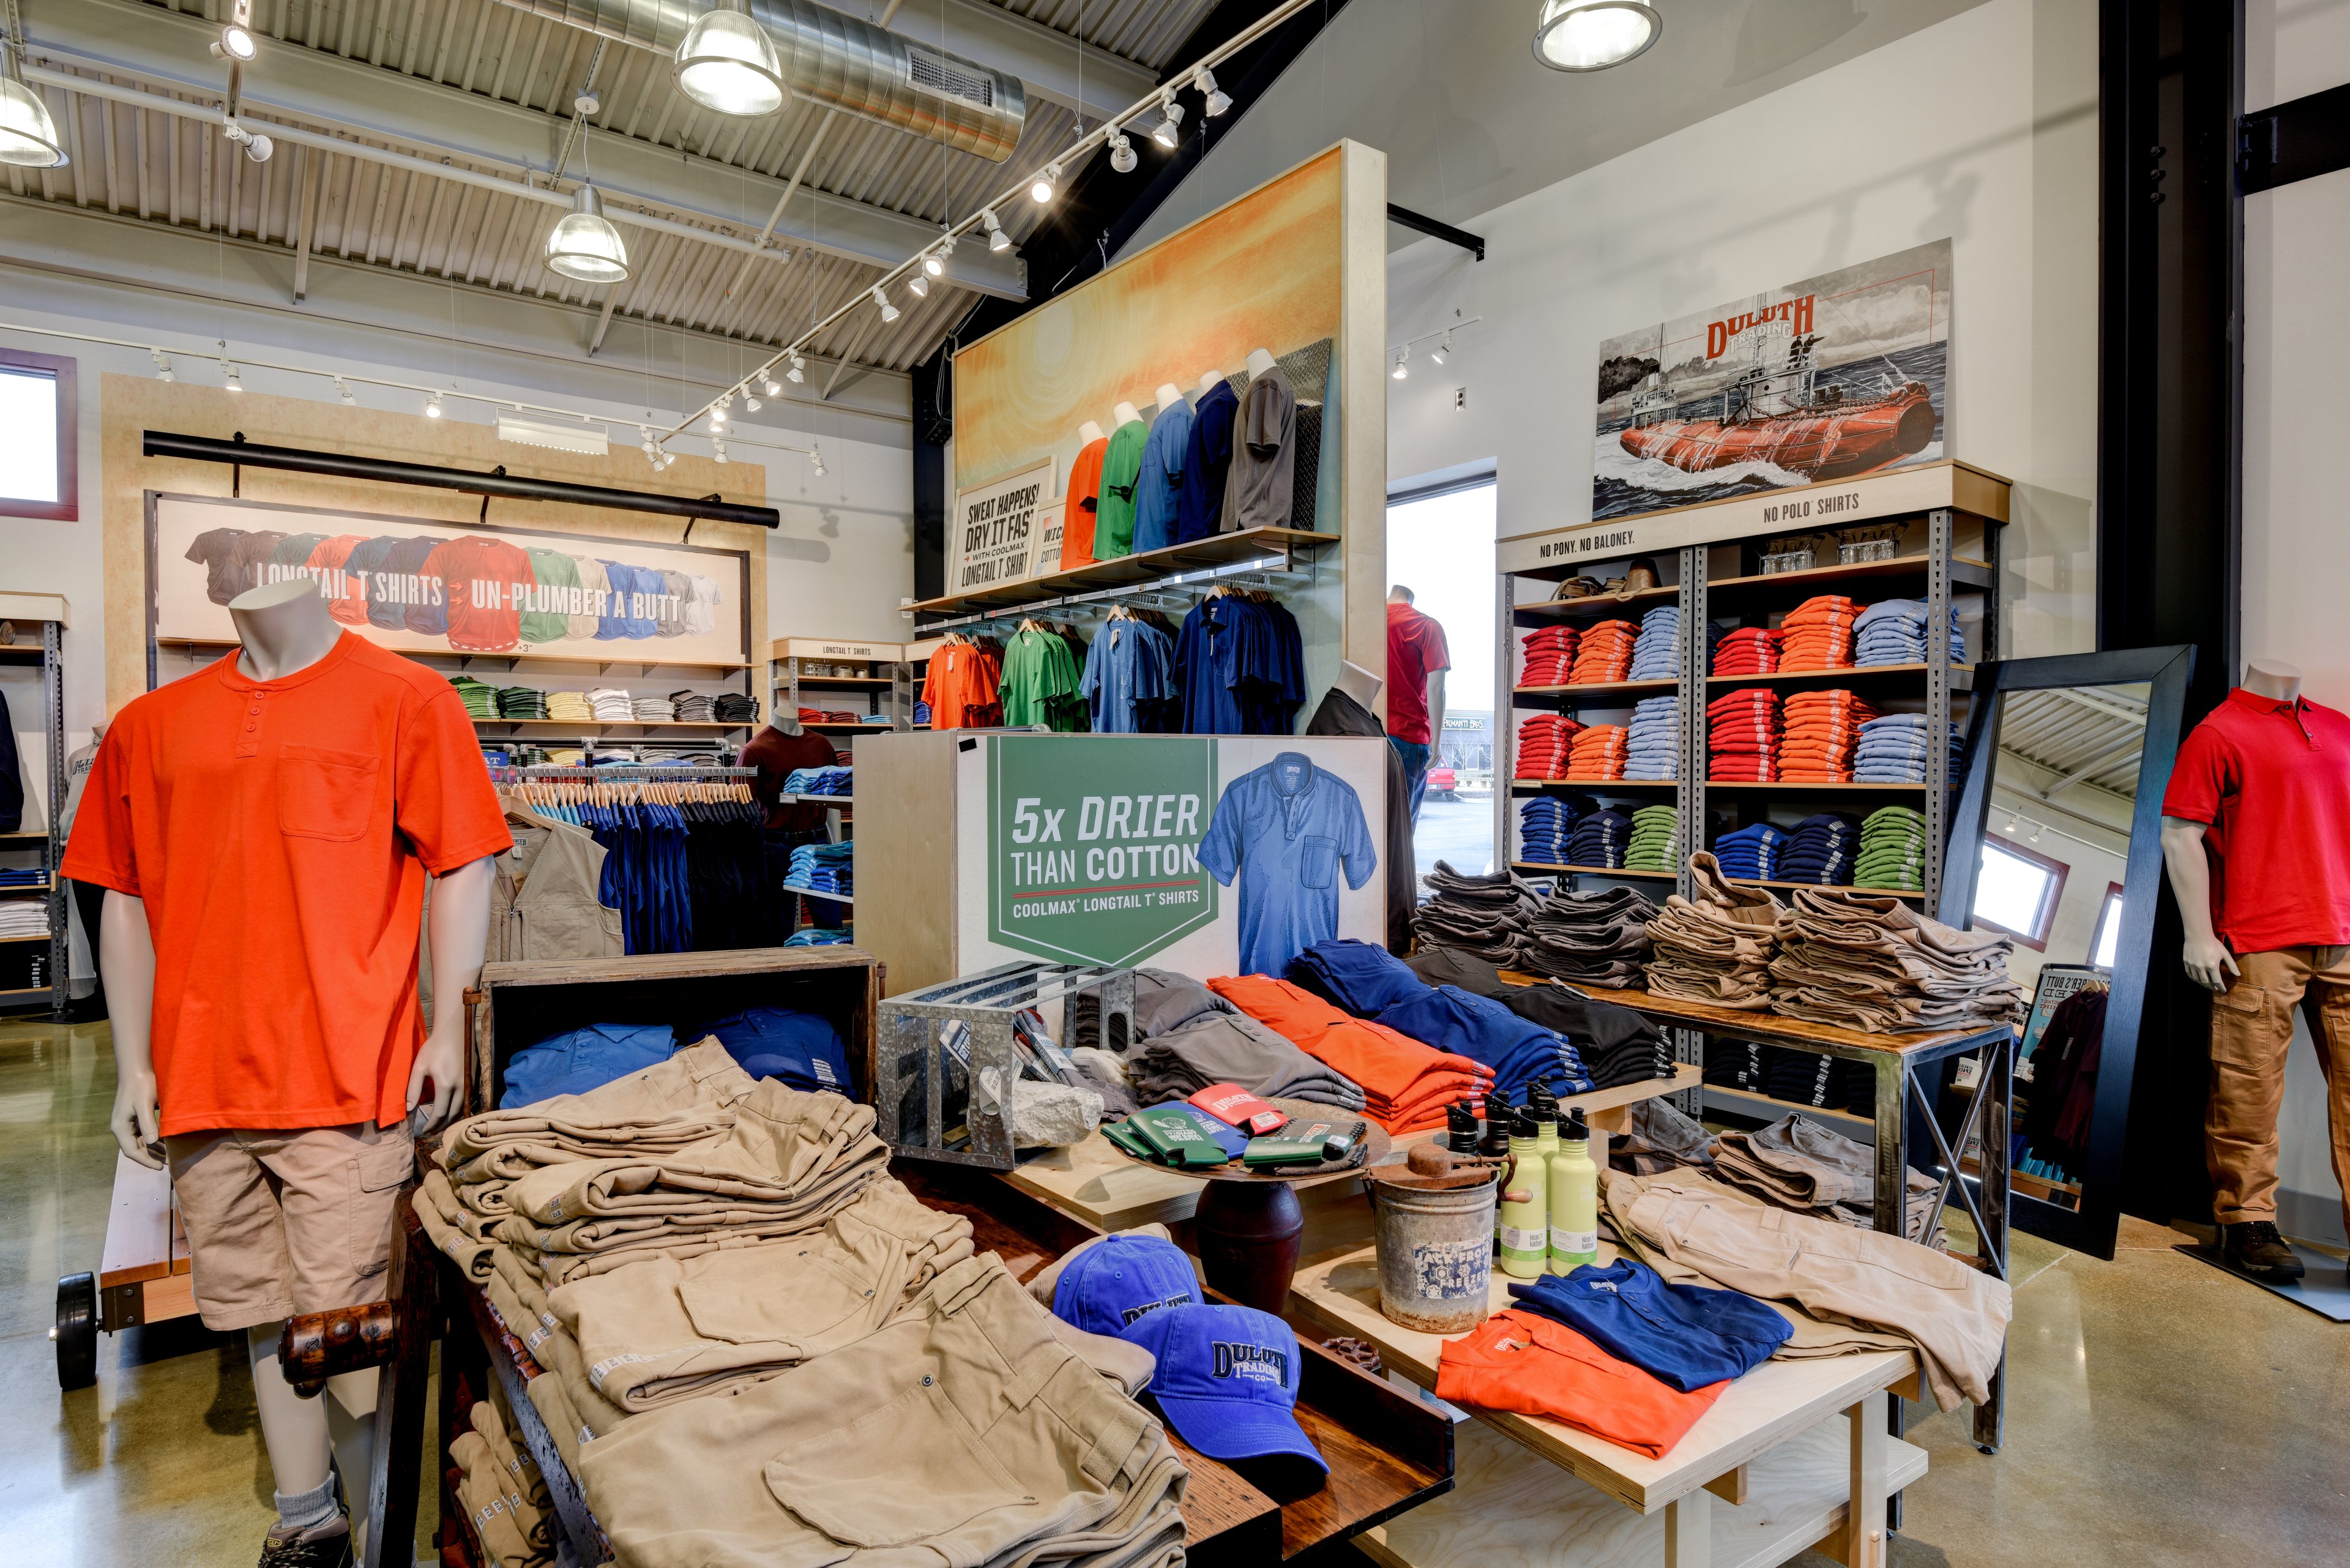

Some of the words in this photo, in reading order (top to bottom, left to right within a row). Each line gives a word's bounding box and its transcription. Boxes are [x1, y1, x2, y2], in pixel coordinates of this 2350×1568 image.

[1706, 294, 1815, 360] DULUTH
[1728, 323, 1792, 354] TRADING
[968, 498, 996, 525] SWEAT
[997, 483, 1040, 515] HAPPENS!
[1763, 507, 1778, 523] NO
[1818, 493, 1859, 515] SHIRTS
[965, 523, 992, 553] DRY
[991, 517, 1007, 547] IT
[1540, 544, 1552, 559] NO
[1554, 540, 1576, 556] PONY.
[1580, 537, 1591, 552] NO
[1593, 530, 1635, 550] BALONEY.
[972, 551, 990, 561] WITH
[961, 558, 998, 588] LONGTAIL
[376, 572, 442, 607] SHIRTS
[471, 579, 608, 618] UN-PLUMBER
[613, 591, 627, 619] A
[633, 592, 681, 622] BUTT
[1442, 718, 1468, 728] PRIMANTI
[1011, 797, 1065, 844] 5x
[1077, 794, 1200, 841] DRIER
[1010, 848, 1076, 887] THAN
[1086, 842, 1199, 881] COTTON
[1084, 892, 1142, 913] LONGTAIL
[1159, 889, 1199, 905] SHIRTS
[1212, 1094, 1259, 1111] DULUTH
[1414, 1252, 1455, 1264] JACK
[1212, 1342, 1289, 1389] DULUTH
[1233, 1362, 1281, 1385] TRADING
